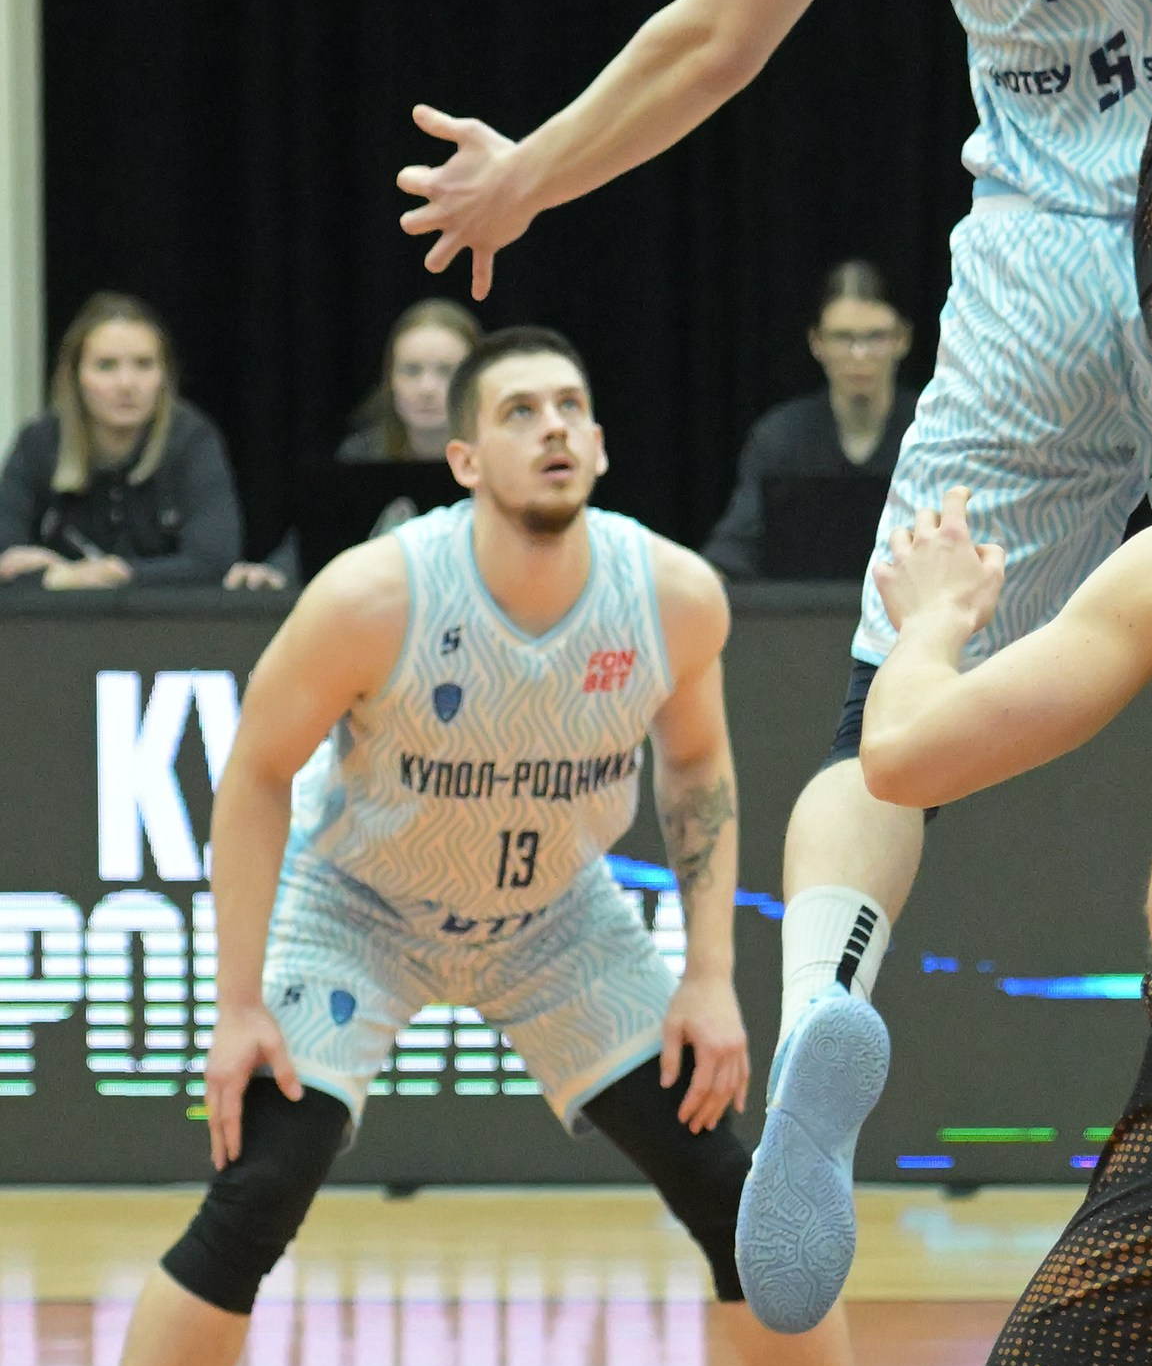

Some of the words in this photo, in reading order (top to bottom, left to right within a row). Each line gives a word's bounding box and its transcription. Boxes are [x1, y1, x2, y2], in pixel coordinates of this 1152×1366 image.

[588, 649, 638, 669] FON
[582, 670, 630, 694] BET
[497, 831, 540, 889] 13
